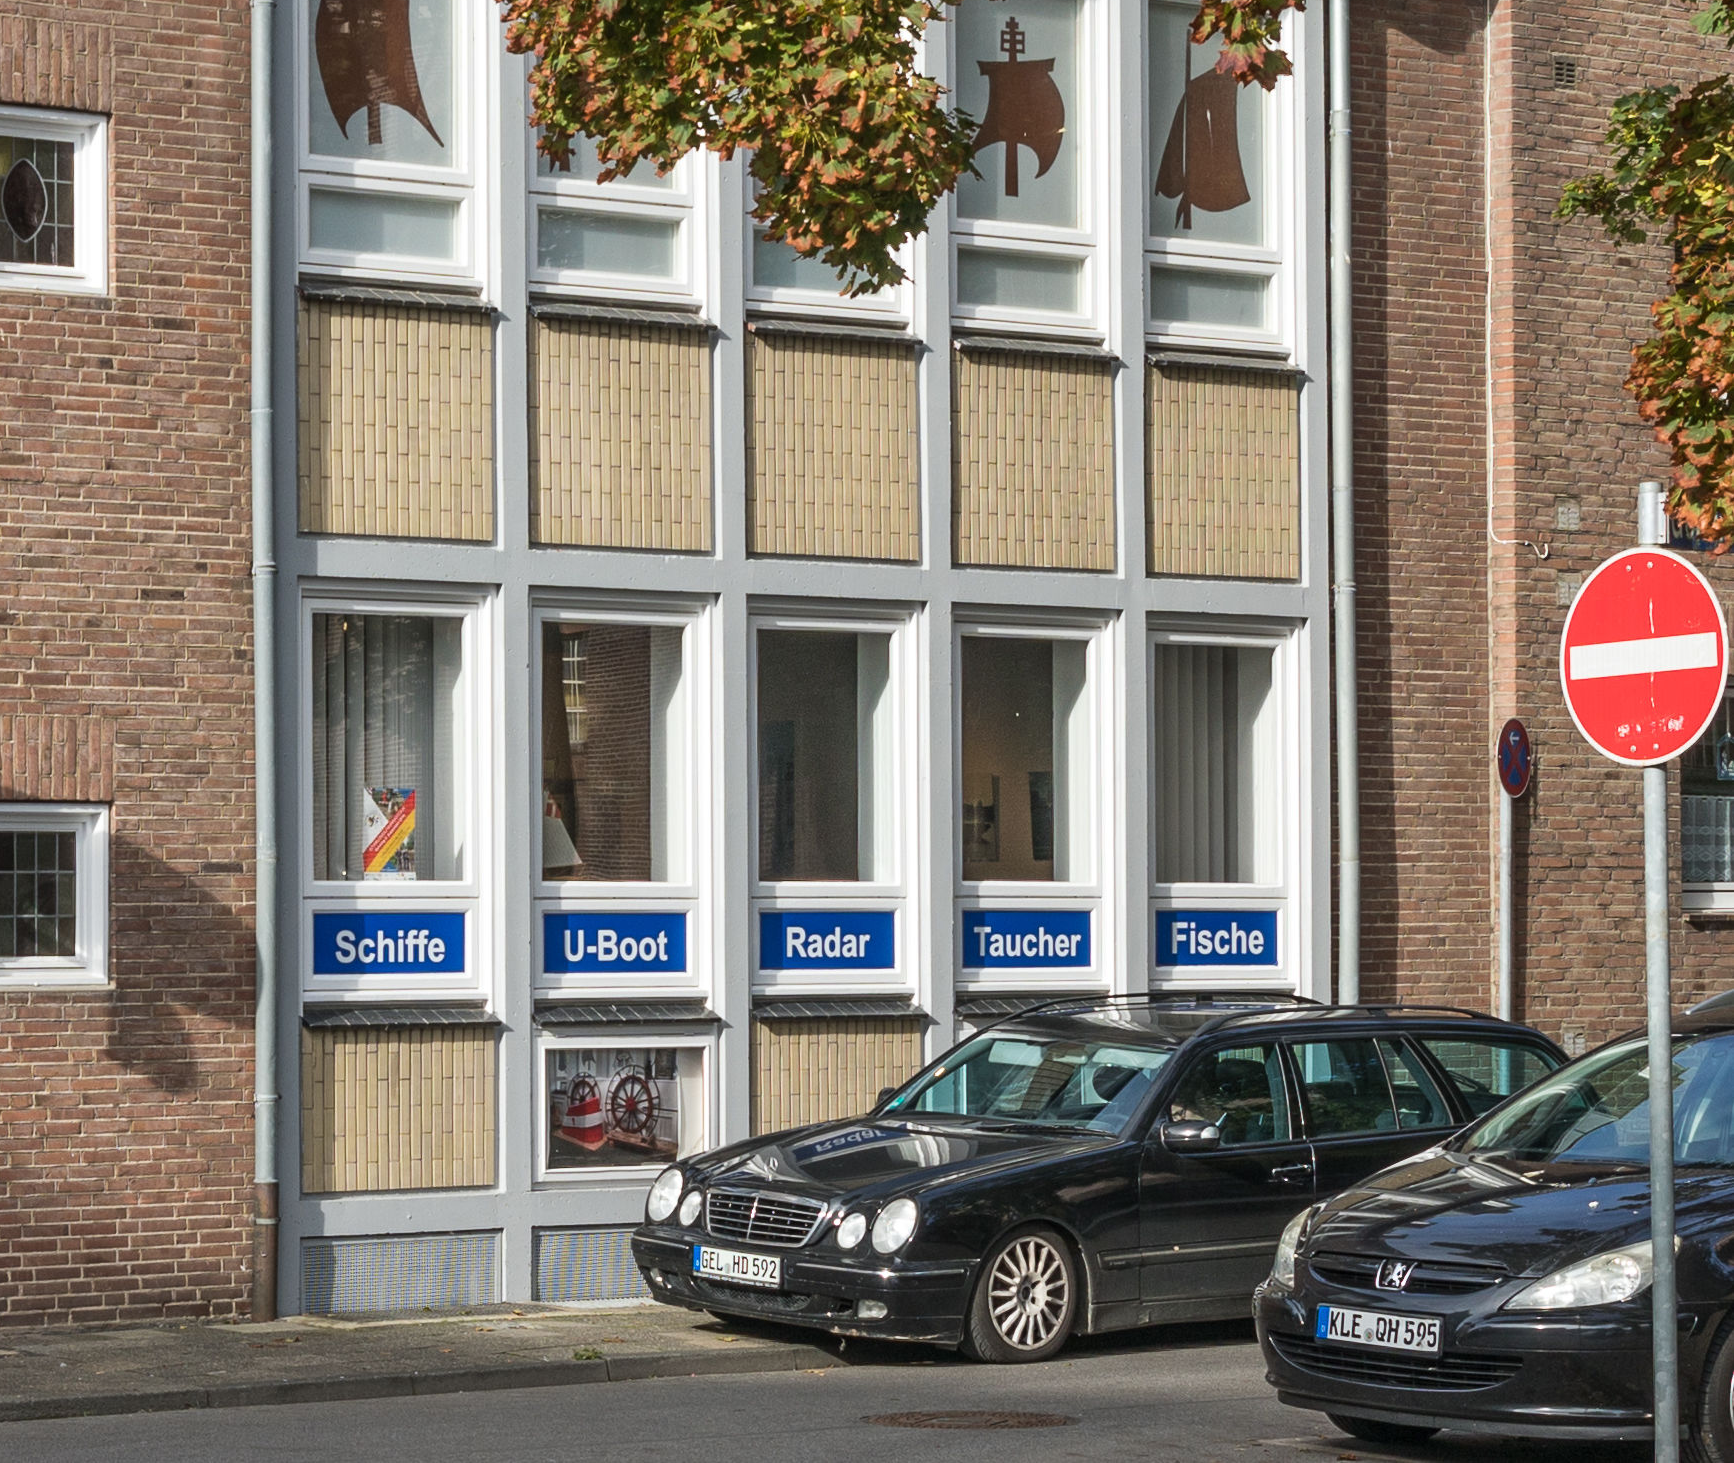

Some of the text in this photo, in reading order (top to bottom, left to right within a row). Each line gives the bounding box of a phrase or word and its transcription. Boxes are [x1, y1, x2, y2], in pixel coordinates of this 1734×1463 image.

[335, 929, 445, 963] Schiffe
[563, 929, 668, 962] U-Boot
[786, 926, 871, 958] Radar
[973, 926, 1081, 957] Taucher
[1172, 922, 1264, 955] Fische
[701, 1251, 777, 1279] GEL HD 592
[1329, 1311, 1362, 1339] KLE
[1375, 1317, 1400, 1344] QH
